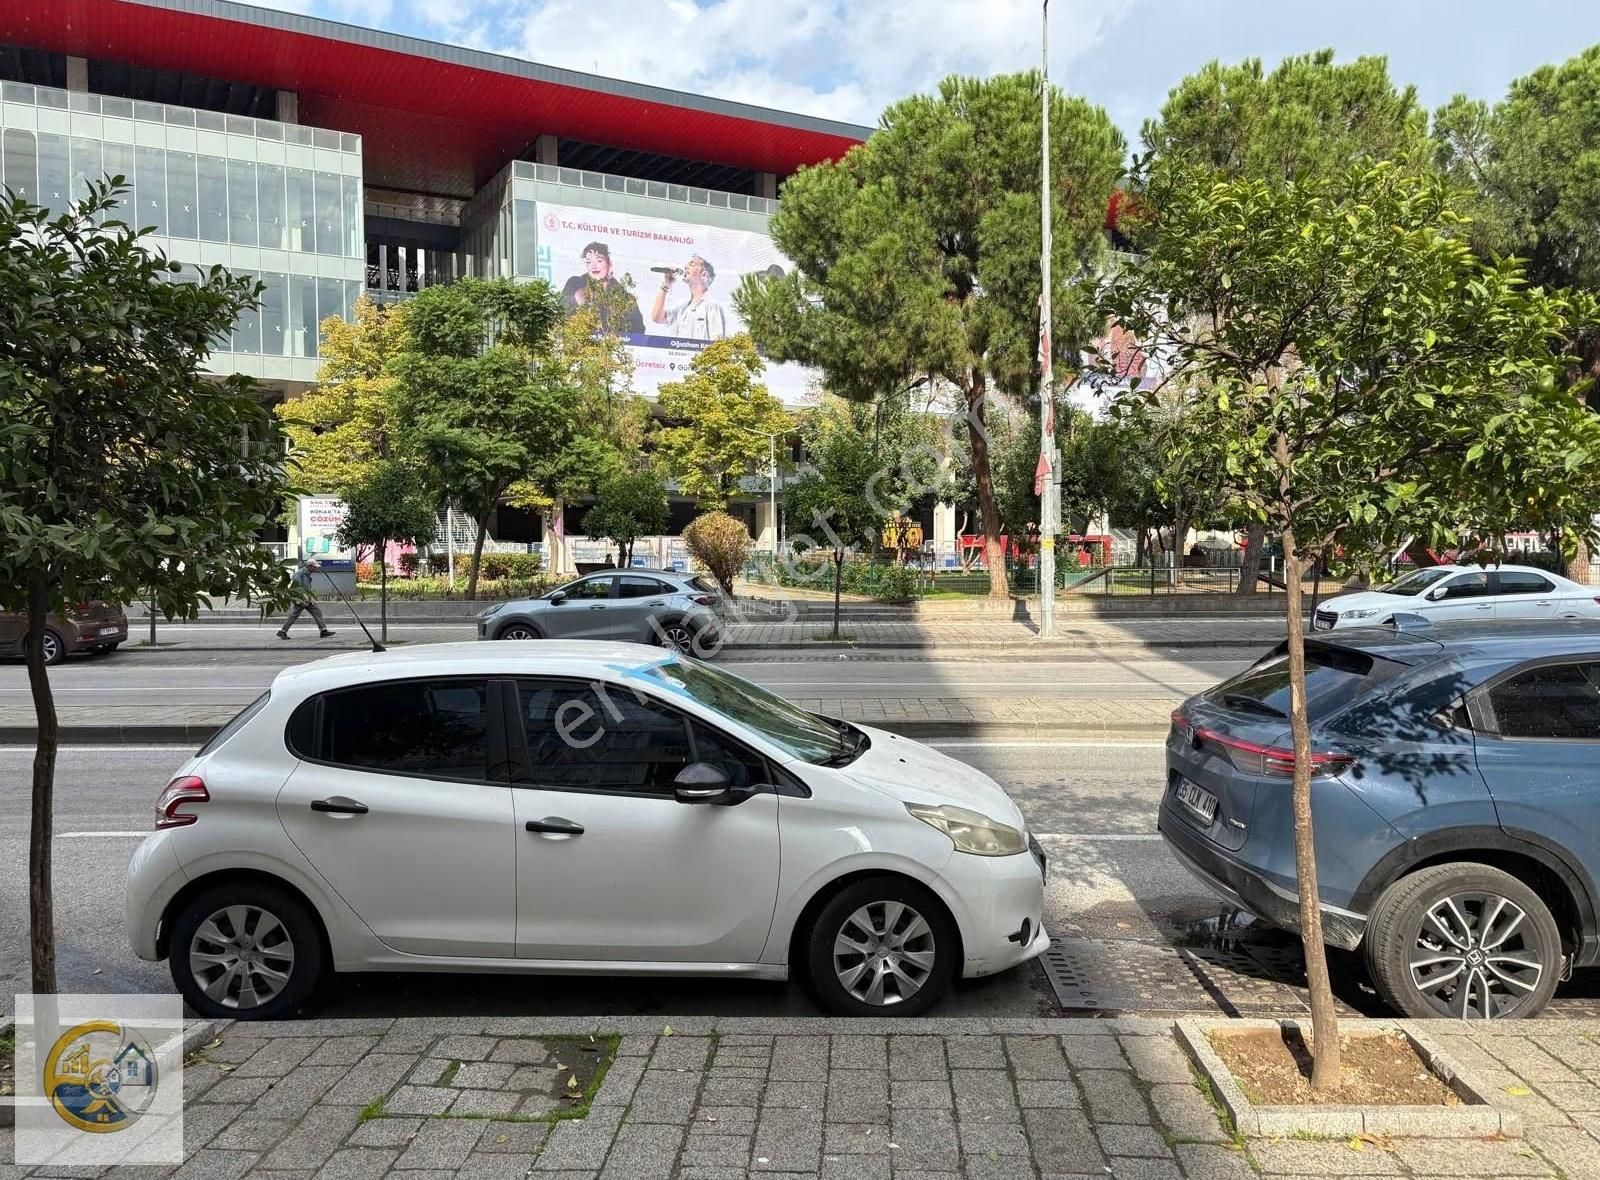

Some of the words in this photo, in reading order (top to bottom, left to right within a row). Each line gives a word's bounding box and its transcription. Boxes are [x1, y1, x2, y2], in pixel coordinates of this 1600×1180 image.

[561, 221, 576, 230] T.C.
[577, 222, 609, 234] KÜLTÜR
[610, 227, 621, 236] VE
[622, 229, 652, 240] TURİZM
[653, 234, 694, 245] BAKANLIĞI
[670, 340, 699, 349] Oğuzhan
[636, 359, 666, 369] Ücretsiz
